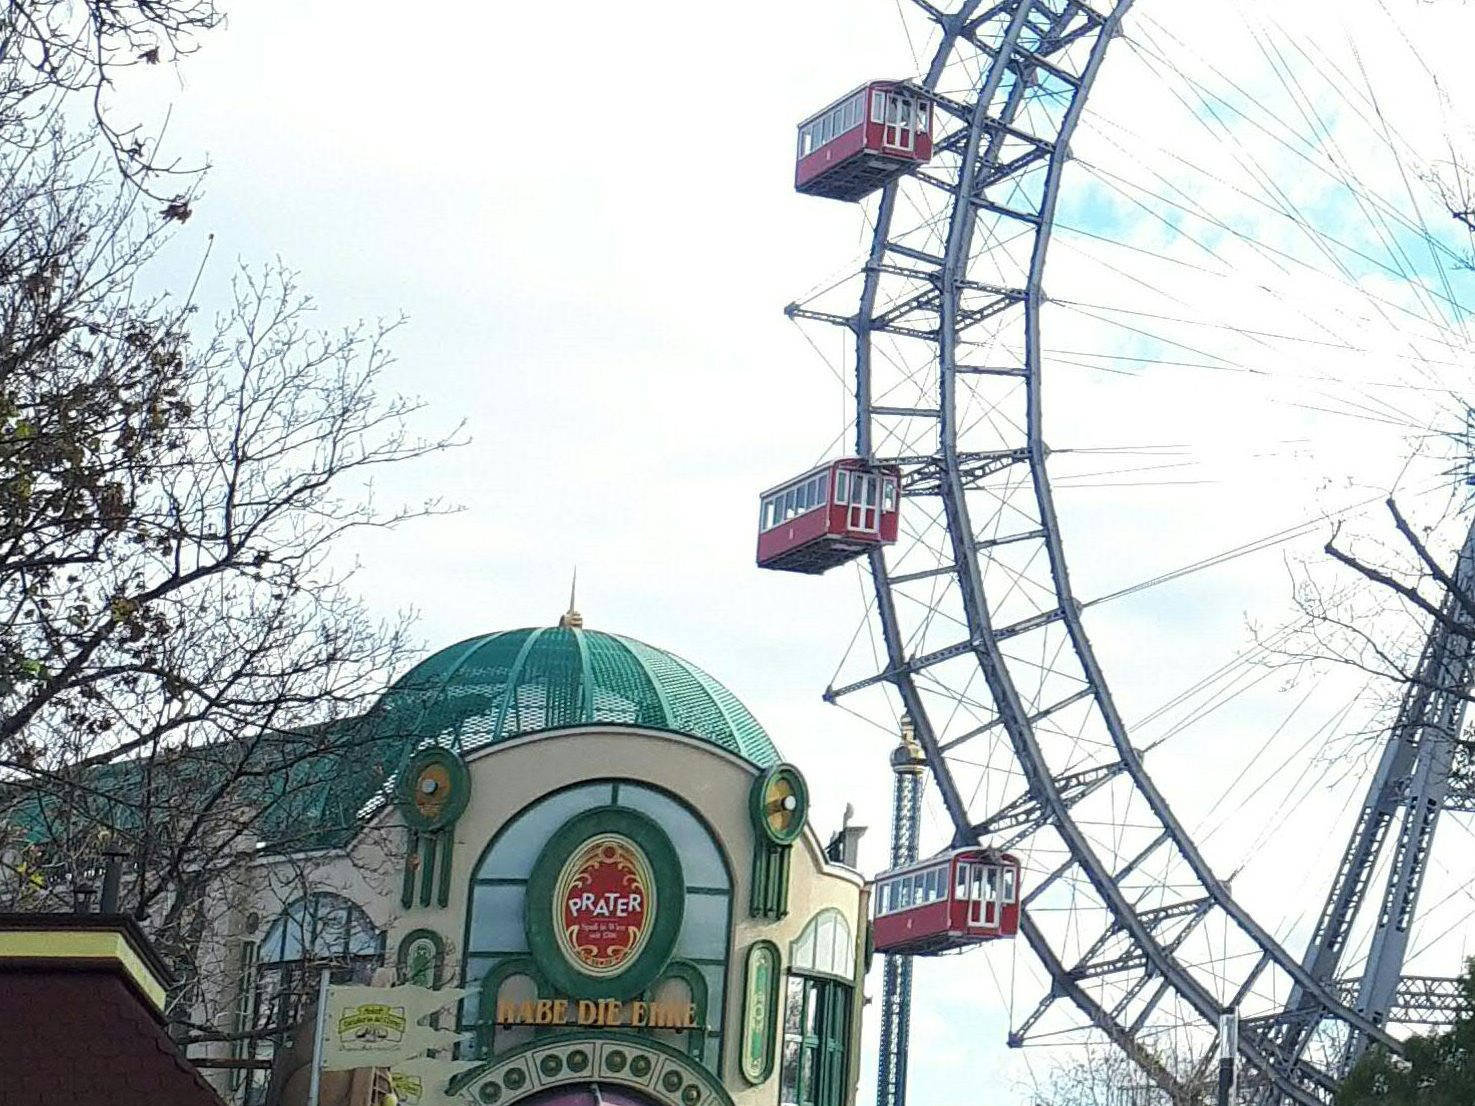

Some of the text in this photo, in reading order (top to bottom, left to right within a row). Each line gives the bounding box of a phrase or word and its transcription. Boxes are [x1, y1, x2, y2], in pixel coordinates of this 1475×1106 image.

[568, 892, 642, 917] PRATER
[497, 999, 569, 1025] HABE
[577, 998, 624, 1026] DIE
